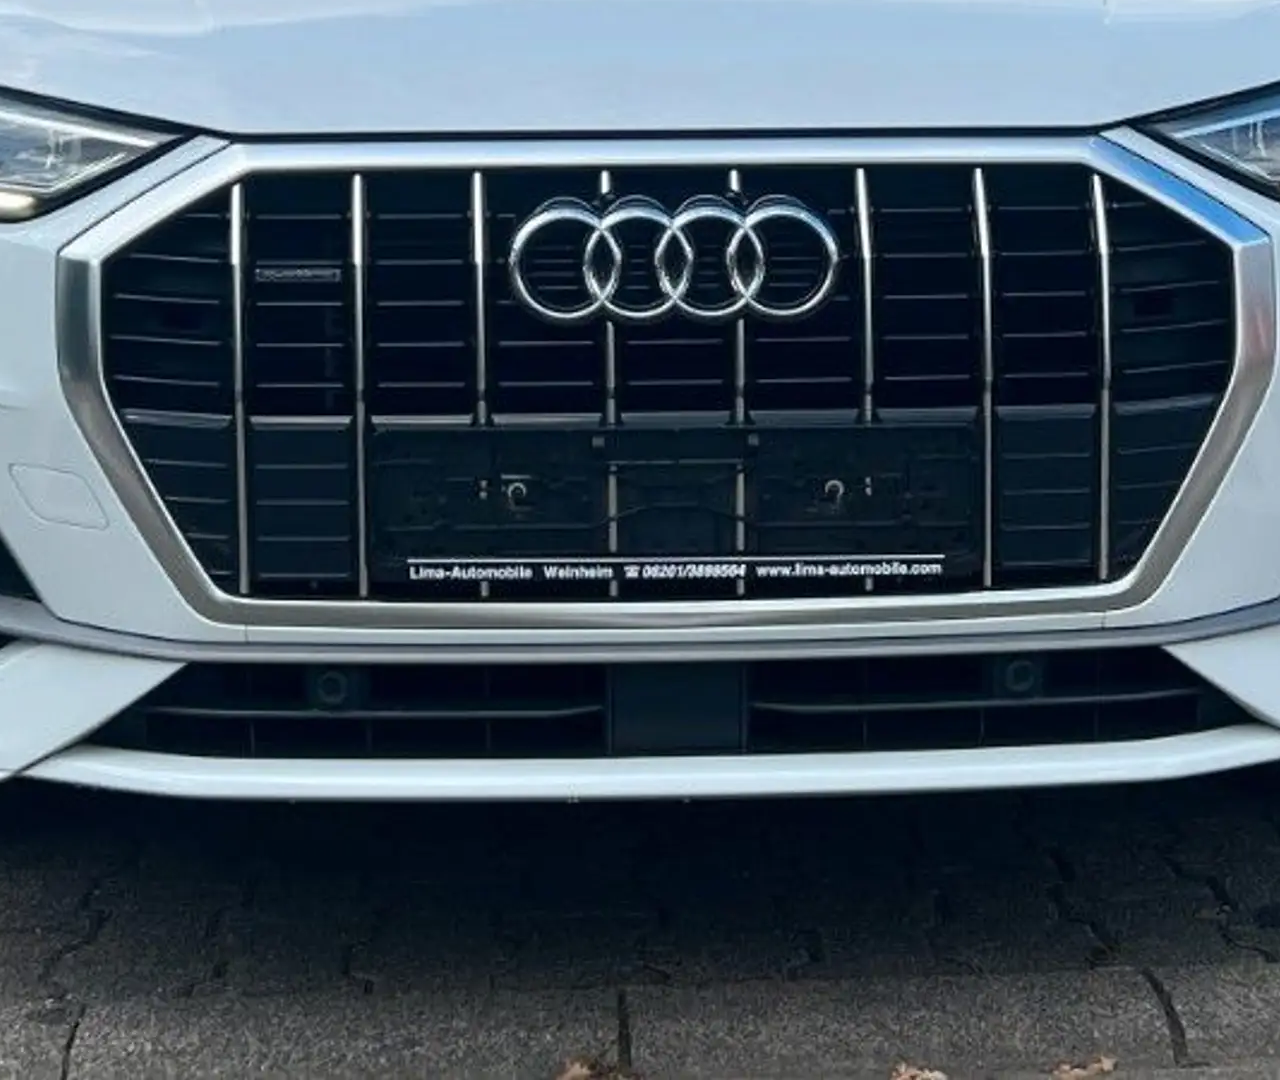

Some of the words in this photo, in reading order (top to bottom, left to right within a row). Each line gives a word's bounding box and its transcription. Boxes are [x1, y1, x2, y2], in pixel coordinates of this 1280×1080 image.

[409, 565, 533, 580] Lima-Automobile
[544, 565, 613, 580] Weinheim
[756, 562, 942, 576] www.lima-automobile.com
